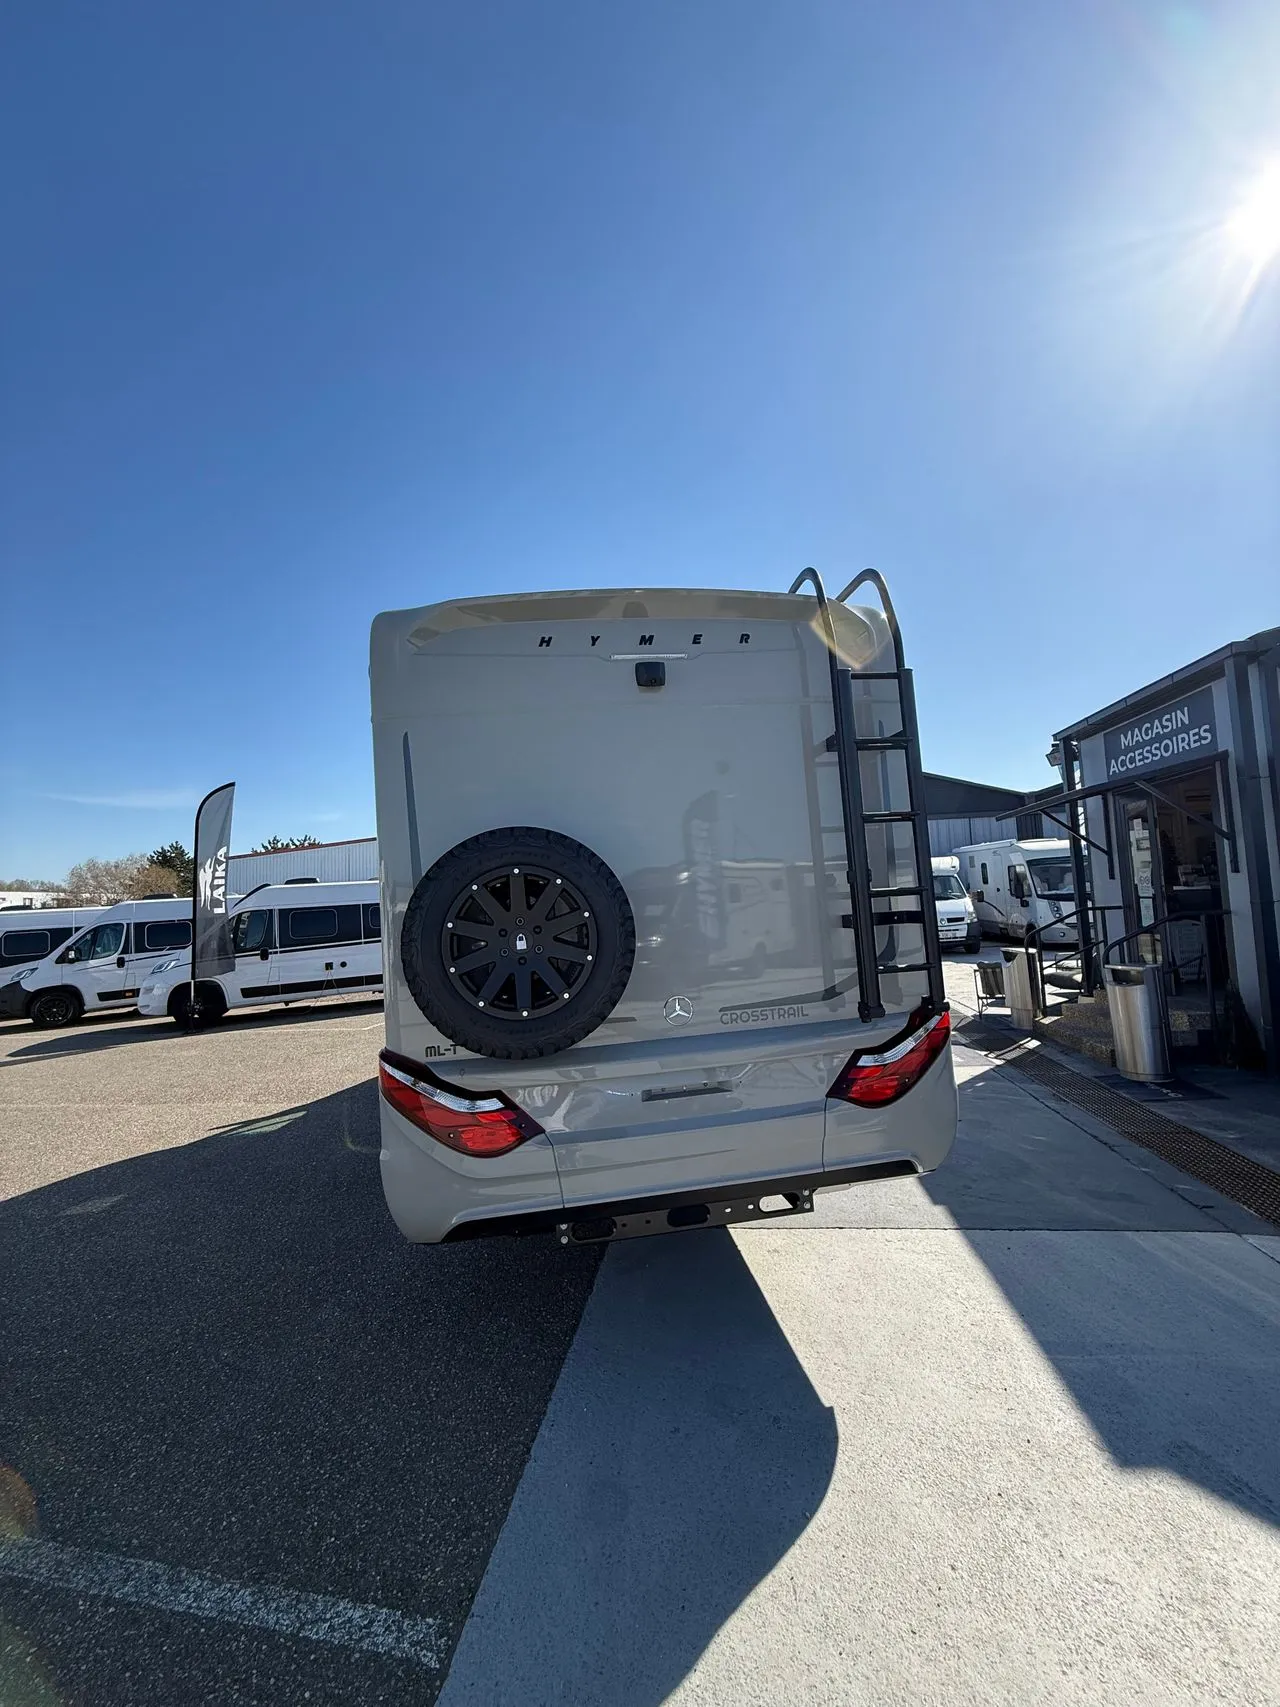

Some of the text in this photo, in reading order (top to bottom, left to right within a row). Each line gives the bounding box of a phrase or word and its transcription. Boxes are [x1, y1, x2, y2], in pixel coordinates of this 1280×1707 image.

[539, 634, 750, 647] HYMER
[1109, 724, 1212, 776] ACCESSOIRES
[1120, 706, 1189, 750] MAGASIN
[212, 846, 227, 914] LAIKA
[720, 1005, 809, 1025] CROSSTRAIL
